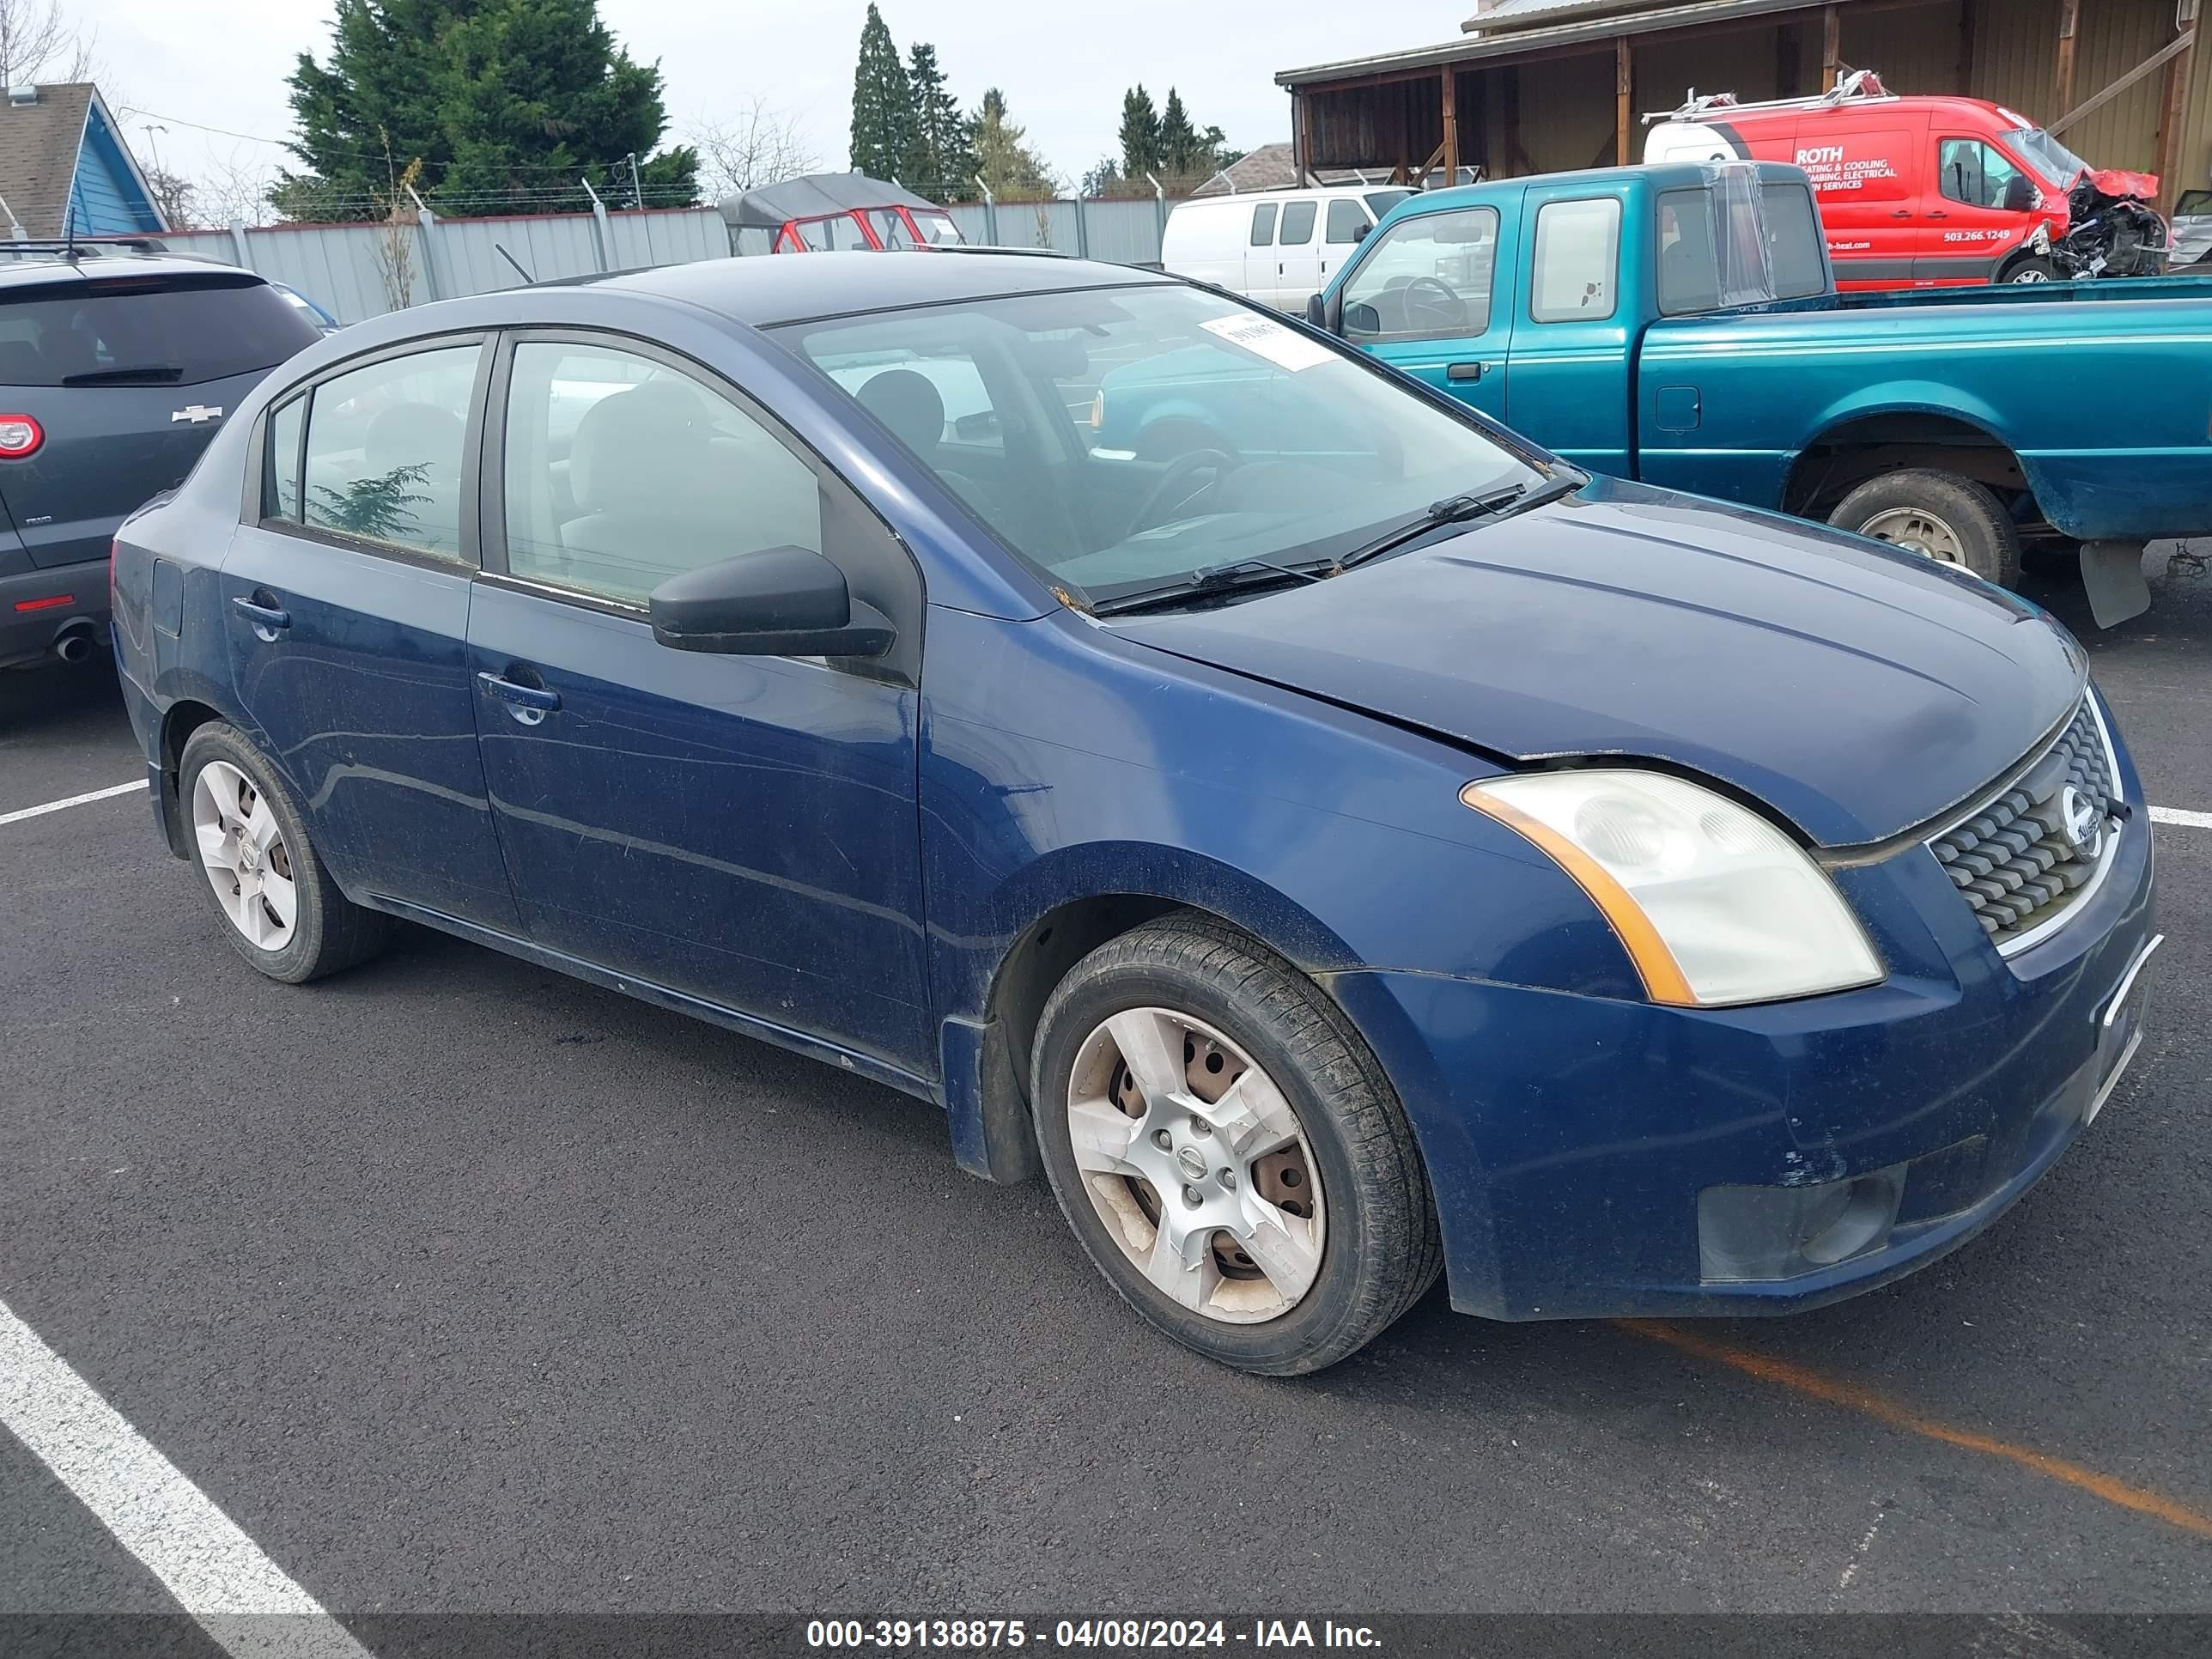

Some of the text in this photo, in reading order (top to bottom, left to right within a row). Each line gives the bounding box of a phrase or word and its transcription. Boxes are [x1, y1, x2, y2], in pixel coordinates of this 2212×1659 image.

[1796, 146, 1844, 165] ROTH
[1802, 164, 1832, 173] EATING
[1844, 159, 1887, 171] COOLING
[1822, 179, 1863, 191] SERVICES
[1943, 229, 2010, 241] 503.266.1249
